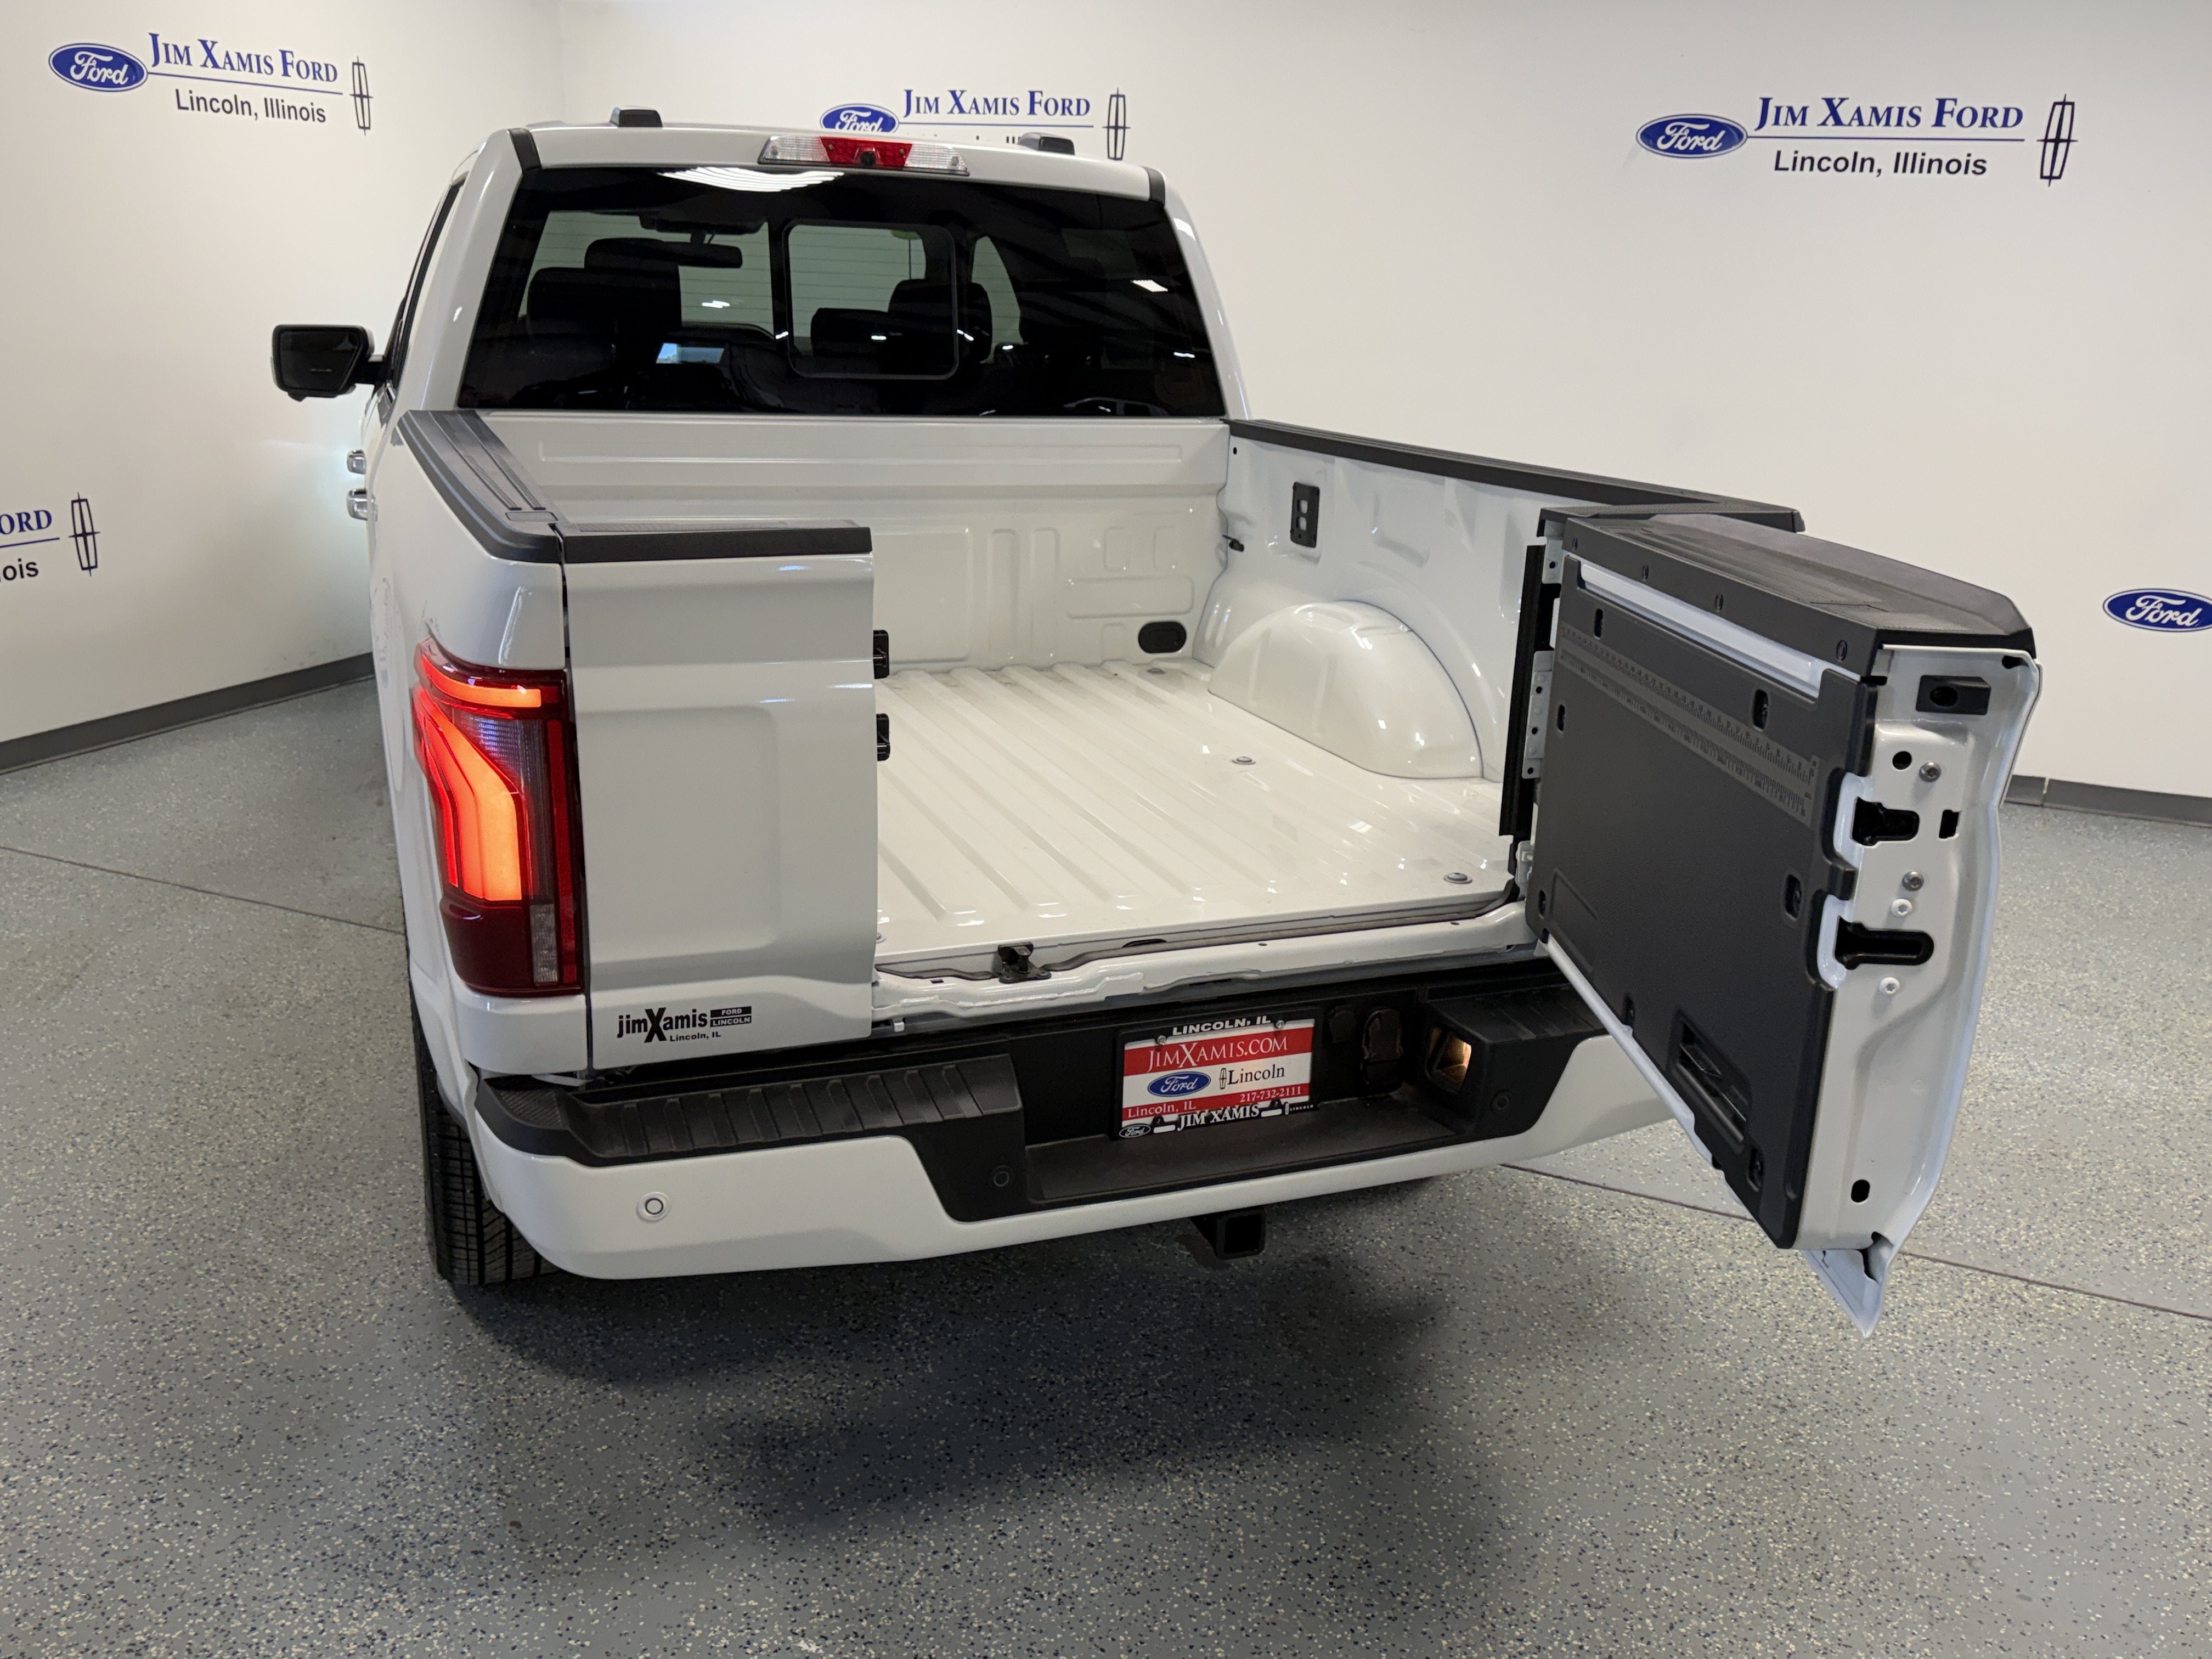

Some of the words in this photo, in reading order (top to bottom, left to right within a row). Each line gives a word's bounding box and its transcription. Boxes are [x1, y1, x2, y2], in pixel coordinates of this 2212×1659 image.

[70, 51, 128, 85] Ford
[197, 38, 274, 76] XAMIS
[279, 49, 338, 82] FORD
[175, 88, 258, 121] Lincoln,
[264, 97, 326, 123] Illinois
[947, 90, 1019, 116] XAMIS
[1027, 90, 1091, 117] FORD
[1817, 97, 1922, 128] XAMIS
[1931, 97, 2024, 129] FORD
[835, 110, 883, 132] Ford
[1656, 122, 1726, 151] Ford
[1774, 150, 1882, 178] Lincoln,
[1893, 152, 1988, 176] Illinois
[2125, 595, 2203, 627] Ford
[712, 1017, 751, 1026] LINCOLN
[1172, 1019, 1251, 1036] LINCOLN,
[1256, 1015, 1271, 1024] IL
[670, 1032, 709, 1042] Lincoln,
[1161, 1075, 1197, 1093] Ford
[1228, 1064, 1285, 1085] Lincoln
[1240, 1086, 1301, 1103] 217-732-2111
[1128, 1103, 1179, 1118] Lincoln,
[1184, 1101, 1197, 1110] IL
[1177, 1111, 1206, 1131] JIM
[1210, 1103, 1260, 1124] XAMIS
[1125, 1127, 1145, 1137] Ford
